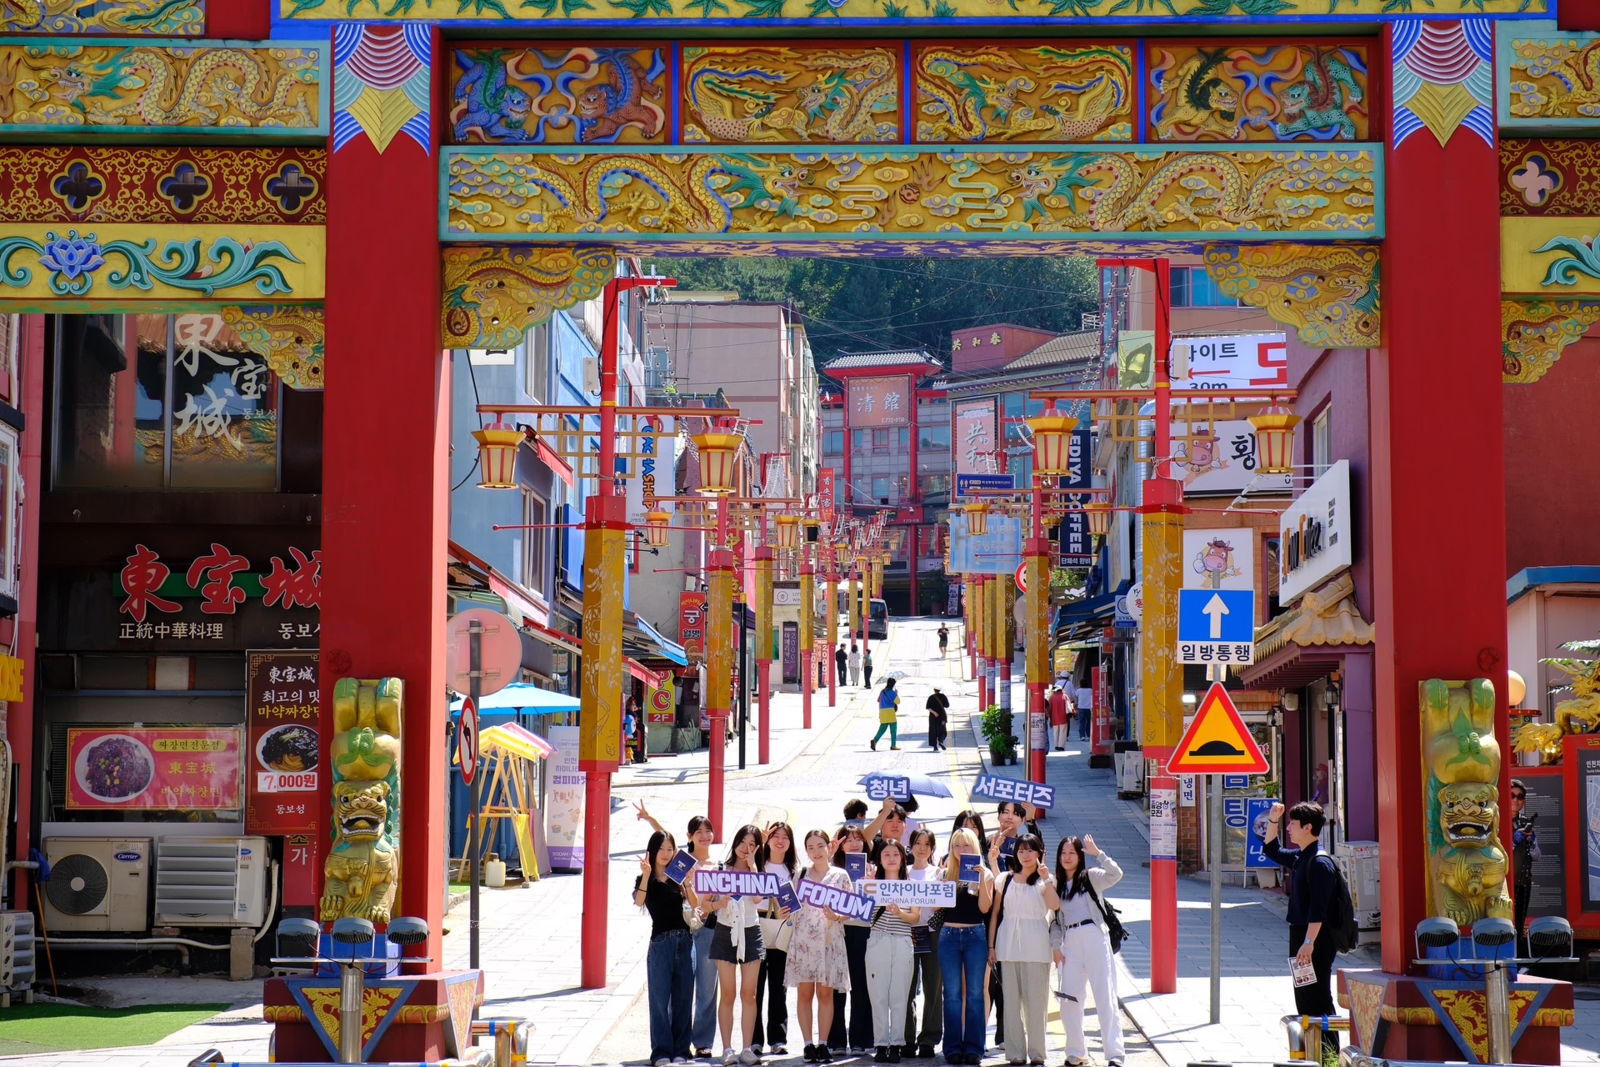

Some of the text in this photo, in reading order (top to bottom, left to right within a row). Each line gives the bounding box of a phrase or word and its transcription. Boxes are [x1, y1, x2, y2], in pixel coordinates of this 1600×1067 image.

[857, 391, 900, 413] 清館
[242, 408, 277, 420] 동보성
[965, 420, 989, 474] 共和
[1069, 435, 1082, 484] EDIYA
[119, 623, 224, 640] 正統中華料理
[1181, 644, 1251, 661] 일방통행
[268, 666, 316, 684] 東宝城
[262, 689, 303, 704] 최고의
[159, 740, 220, 751] 짜장면전문점
[168, 761, 218, 775] 東宝城
[161, 786, 219, 798] 마약짜장면
[870, 779, 908, 799] 청년
[975, 776, 1053, 807] 서포터즈
[275, 804, 306, 815] 동보성
[697, 872, 780, 895] INCHINA
[879, 882, 954, 898] 인차이나포럼
[798, 881, 874, 920] FORUM
